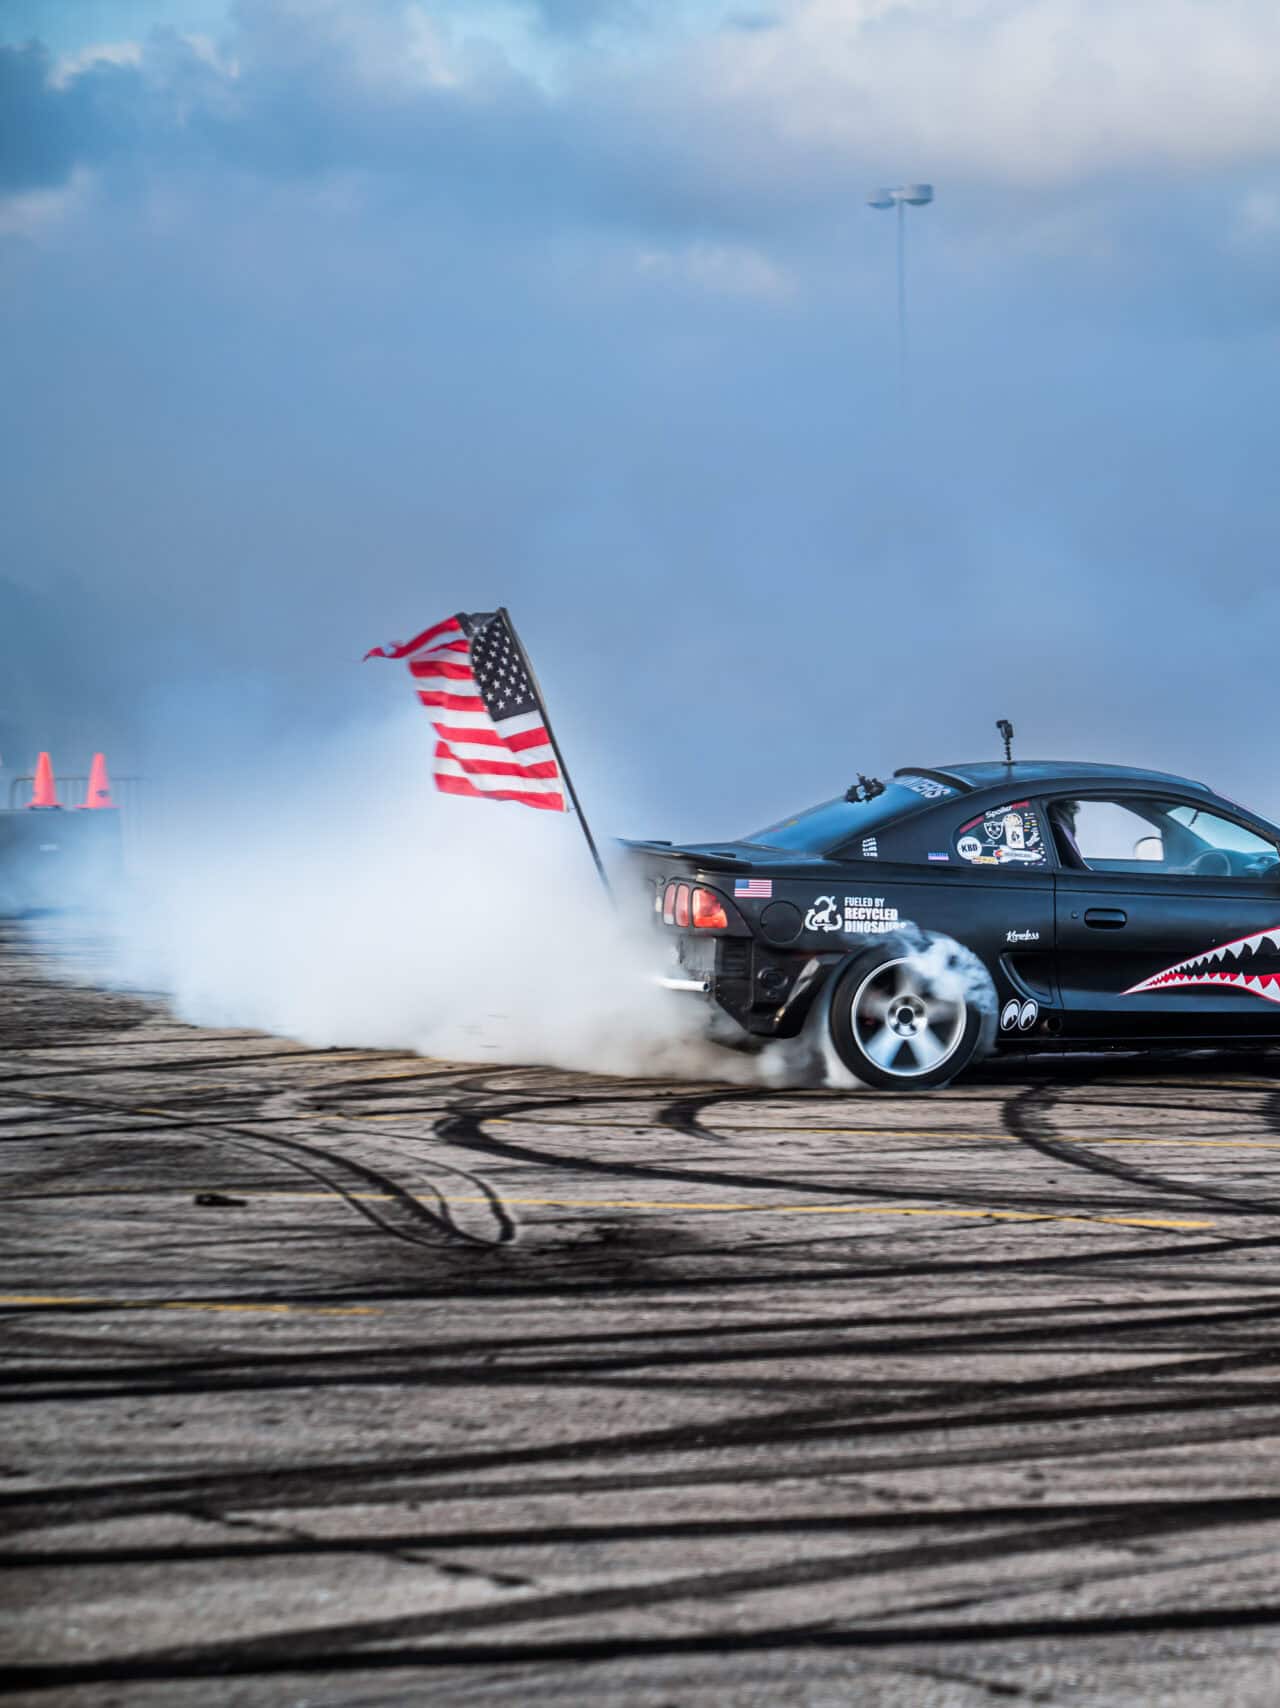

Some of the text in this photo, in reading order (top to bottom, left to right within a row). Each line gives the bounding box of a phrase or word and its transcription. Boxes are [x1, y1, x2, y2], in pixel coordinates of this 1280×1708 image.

[844, 896, 885, 908] FUELED BY
[844, 907, 898, 921] RECYCLED
